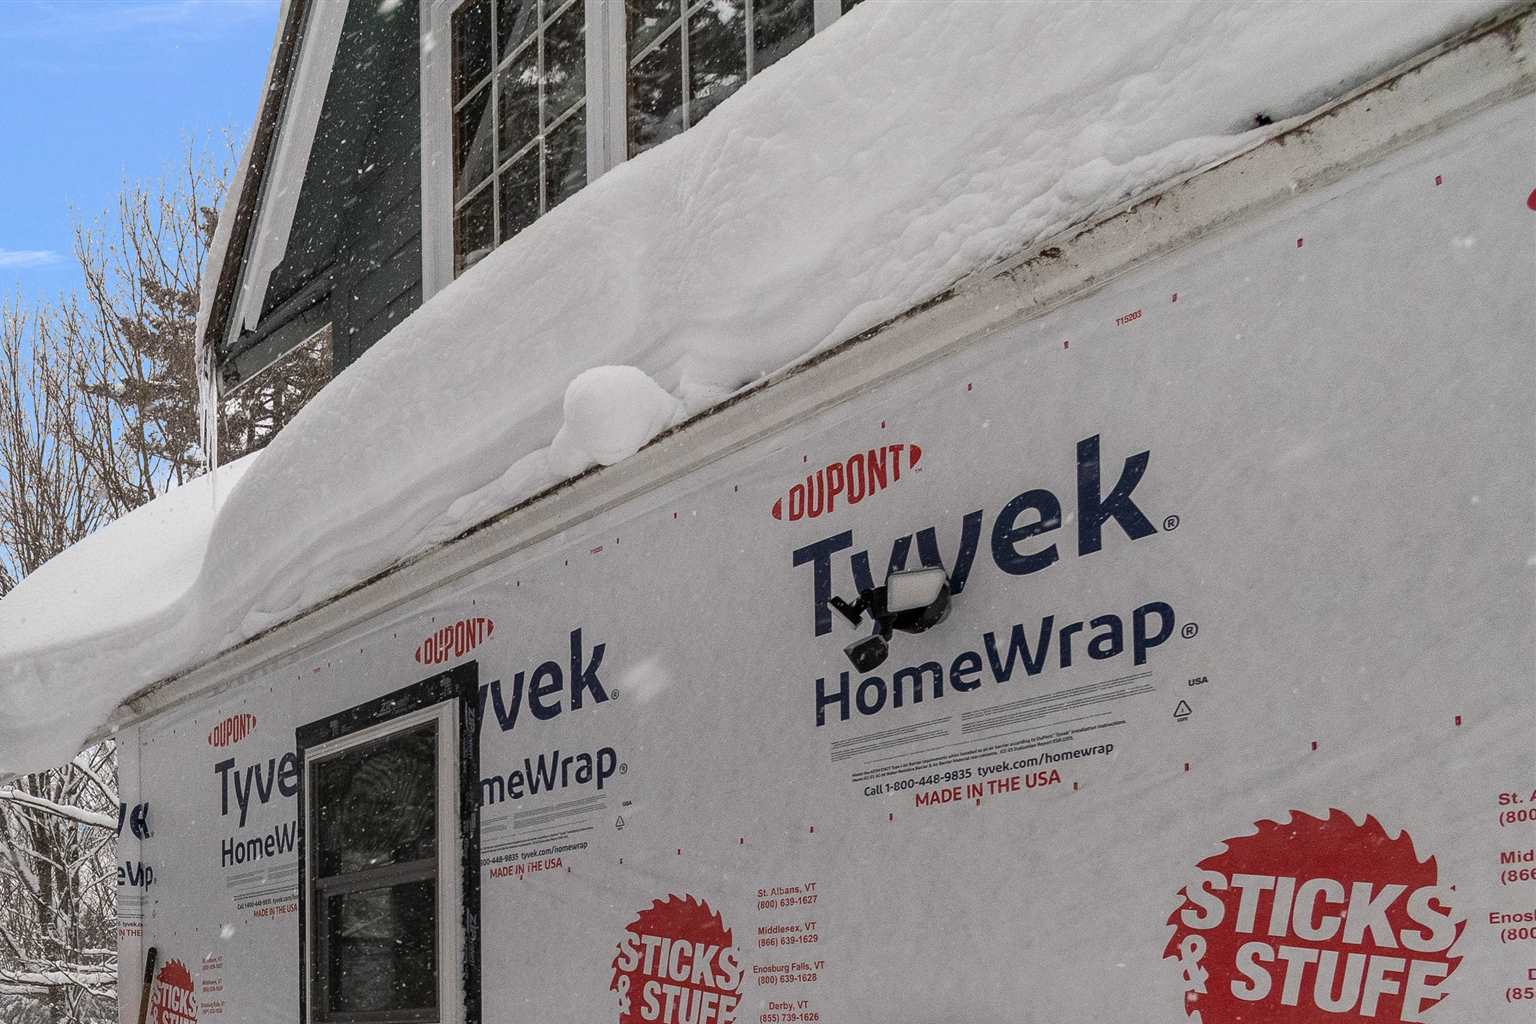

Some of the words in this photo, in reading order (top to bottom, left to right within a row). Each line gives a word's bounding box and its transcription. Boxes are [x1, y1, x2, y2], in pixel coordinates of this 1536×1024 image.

[789, 444, 904, 521] DUPONT
[424, 618, 485, 665] DUPONT
[479, 627, 609, 732] vek
[815, 601, 1176, 727] HomeWrap
[1188, 676, 1208, 687] USA
[213, 714, 252, 747] DUPONT
[480, 746, 617, 807] meWrap
[864, 784, 883, 797] Call
[885, 768, 972, 793] 1-800-448-9835
[977, 743, 1114, 778] tyvek.com/homewrap
[915, 787, 962, 807] MADE
[967, 783, 984, 799] IN
[987, 776, 1020, 795] THE
[1025, 769, 1061, 789] USA
[214, 752, 298, 828] Tyve
[1498, 792, 1523, 805] St.
[221, 821, 297, 867] HomeW
[490, 865, 514, 879] MADE
[544, 857, 563, 871] USA
[771, 886, 802, 896] Albans,
[805, 883, 816, 891] VT
[780, 895, 818, 907] 639-1627
[758, 925, 803, 935] Middlesex,
[805, 922, 816, 930] VT
[1180, 870, 1459, 953] STICKS
[1489, 910, 1536, 924] Enos
[618, 929, 745, 991] STICKS
[753, 964, 789, 973] Enosburg
[791, 962, 812, 971] Falls,
[814, 961, 824, 969] VT
[1180, 934, 1209, 994] &
[1230, 941, 1450, 1024] STUFF
[151, 979, 197, 1018] STICKS
[617, 975, 631, 1016] &
[768, 1002, 795, 1011] Derby,
[1506, 987, 1536, 1003] (85
